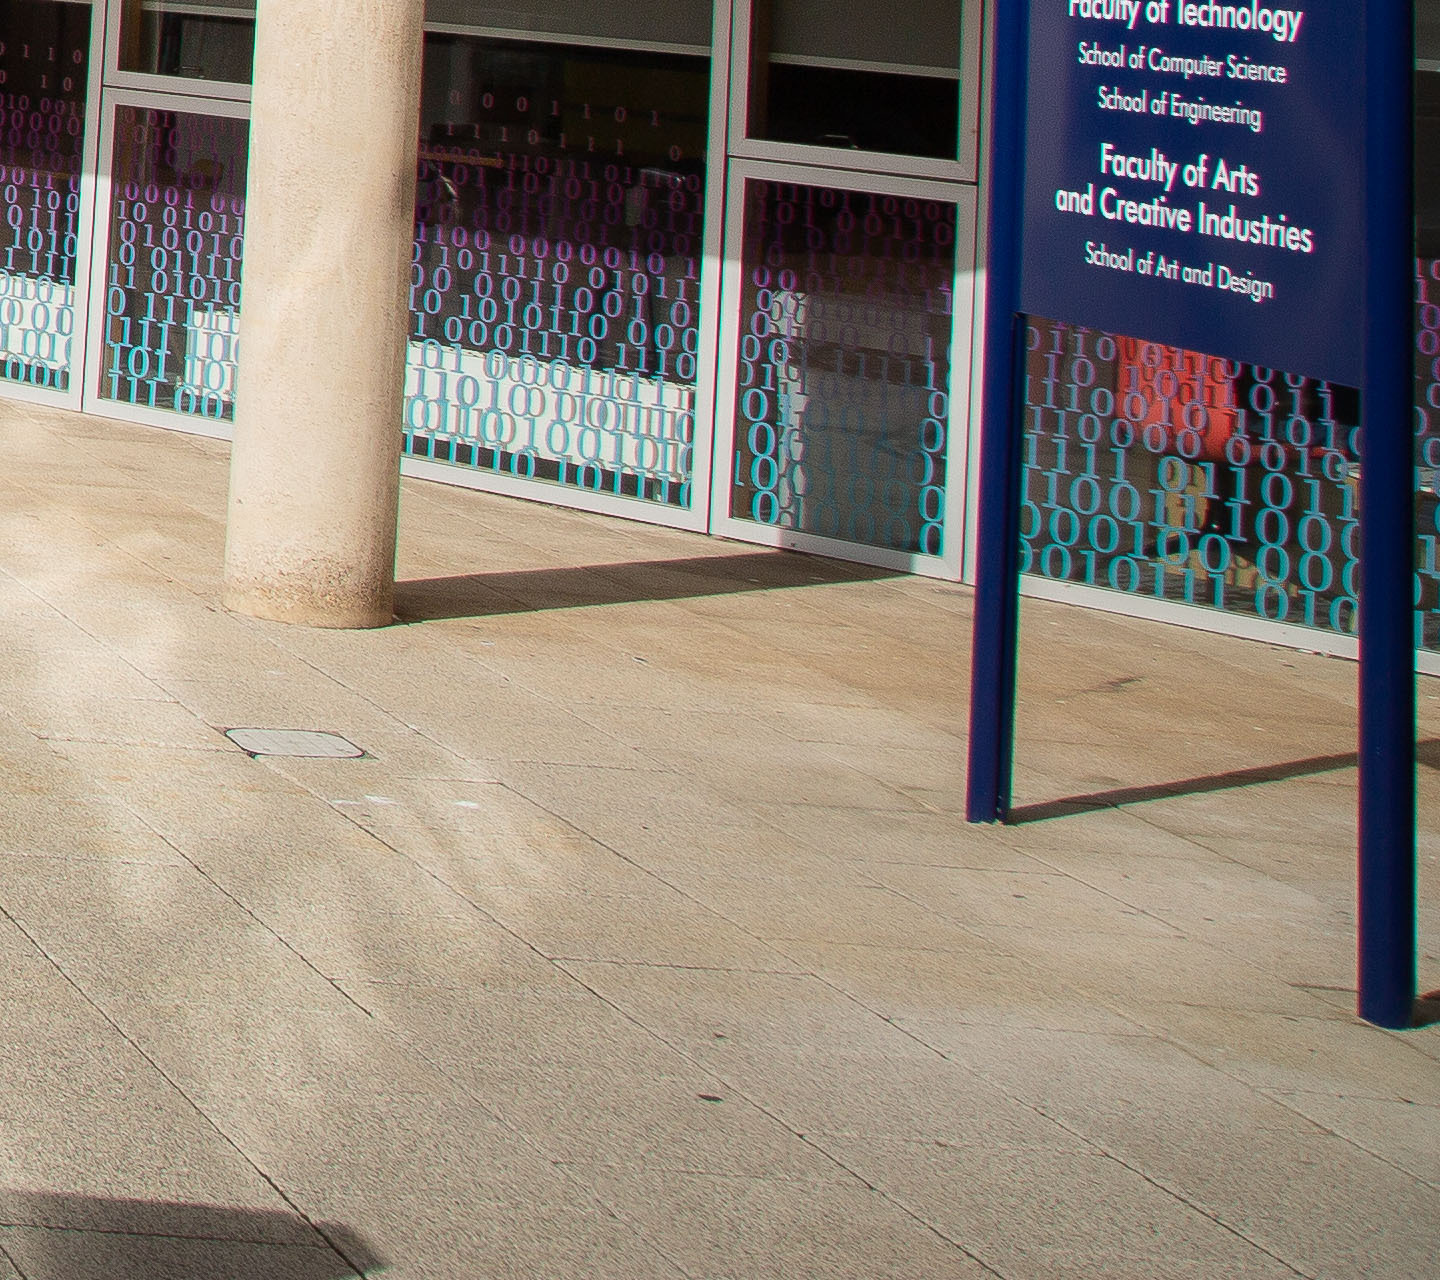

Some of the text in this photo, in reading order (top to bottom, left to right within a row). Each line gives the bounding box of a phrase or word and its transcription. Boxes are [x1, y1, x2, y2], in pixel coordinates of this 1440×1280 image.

[1078, 41, 1289, 85] School of Computer Science
[1098, 85, 1264, 133] School of Engineering
[1100, 142, 1262, 197] Faculty of Arts
[1055, 182, 1315, 254] and Creative Industries
[1084, 240, 1277, 304] School of Art and Design
